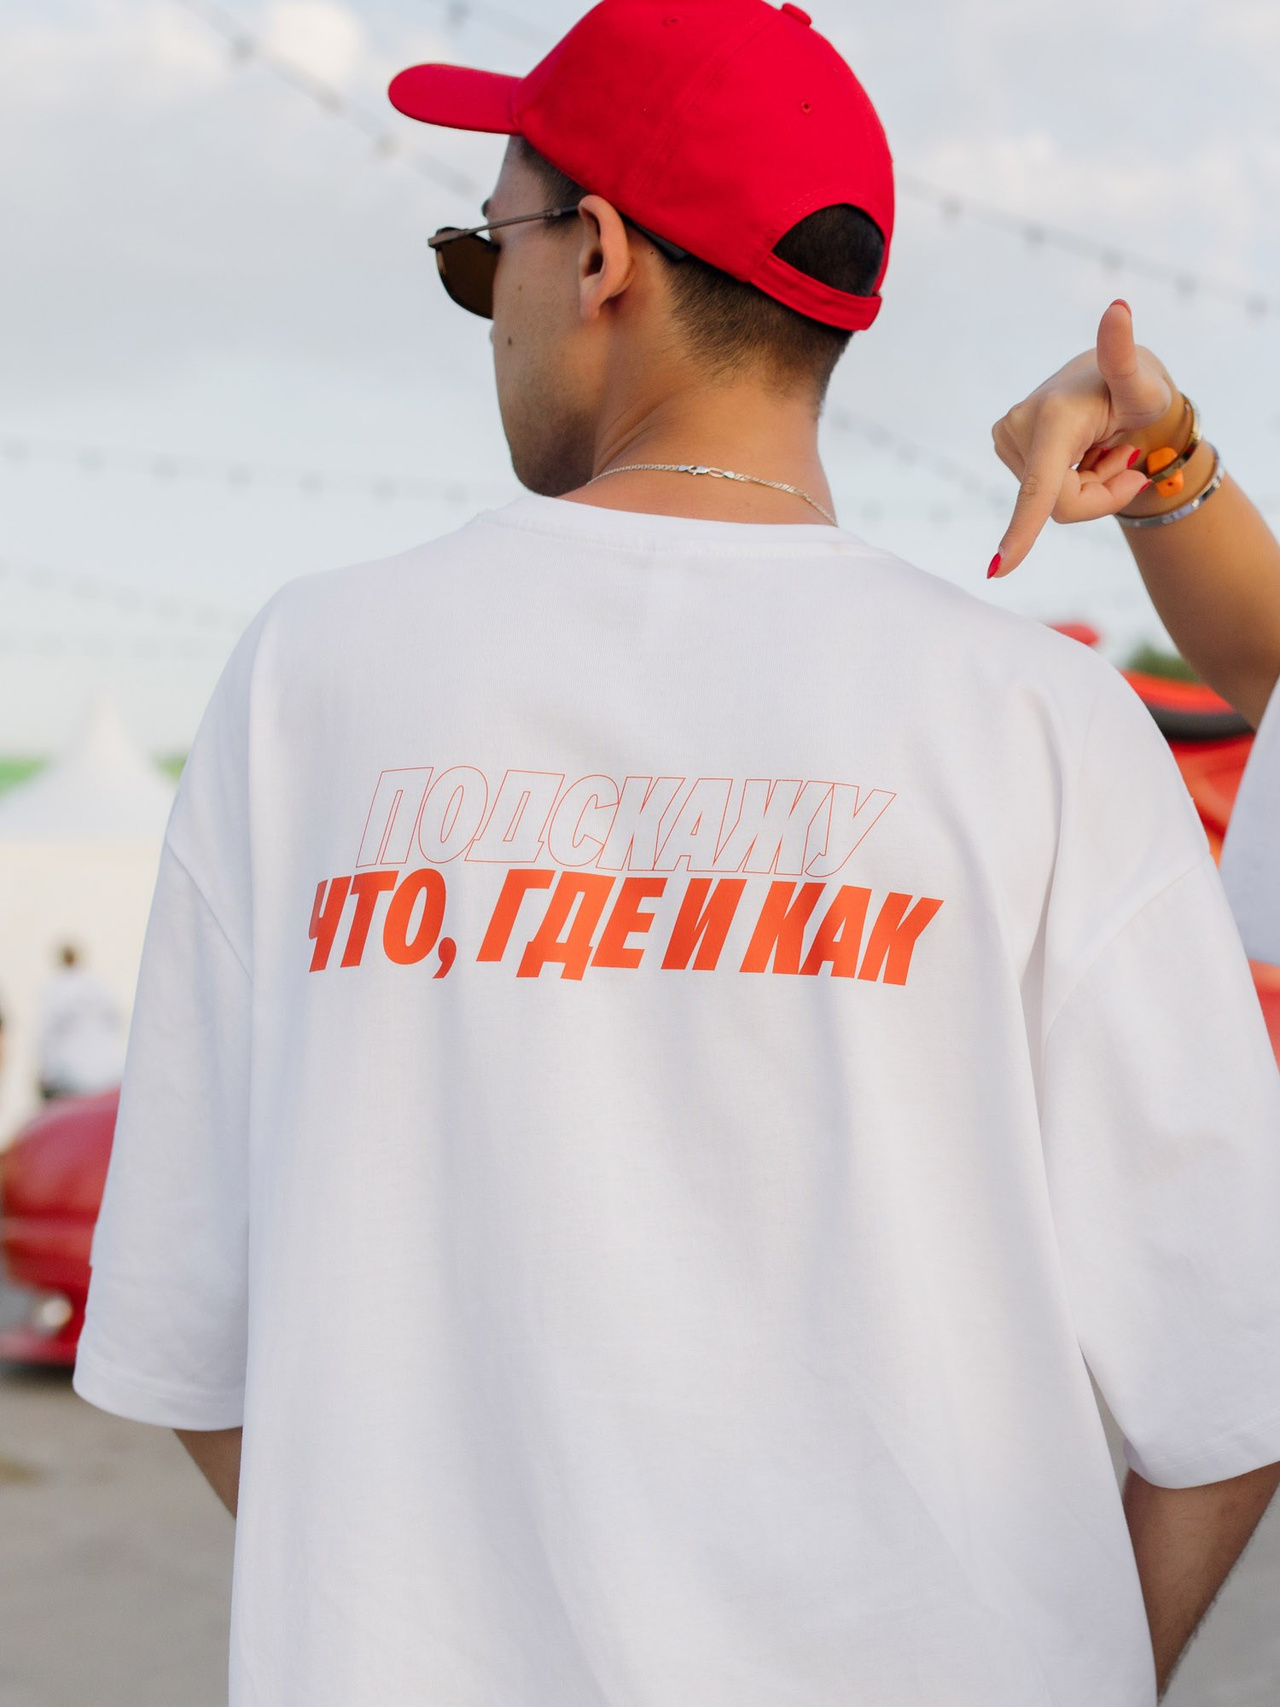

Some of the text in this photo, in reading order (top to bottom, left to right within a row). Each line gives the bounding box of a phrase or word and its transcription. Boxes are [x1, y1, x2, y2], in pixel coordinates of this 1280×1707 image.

[356, 766, 896, 877] ПОДСКАЖУ
[309, 868, 944, 986] ЧТО, ГДЕ И КАК
